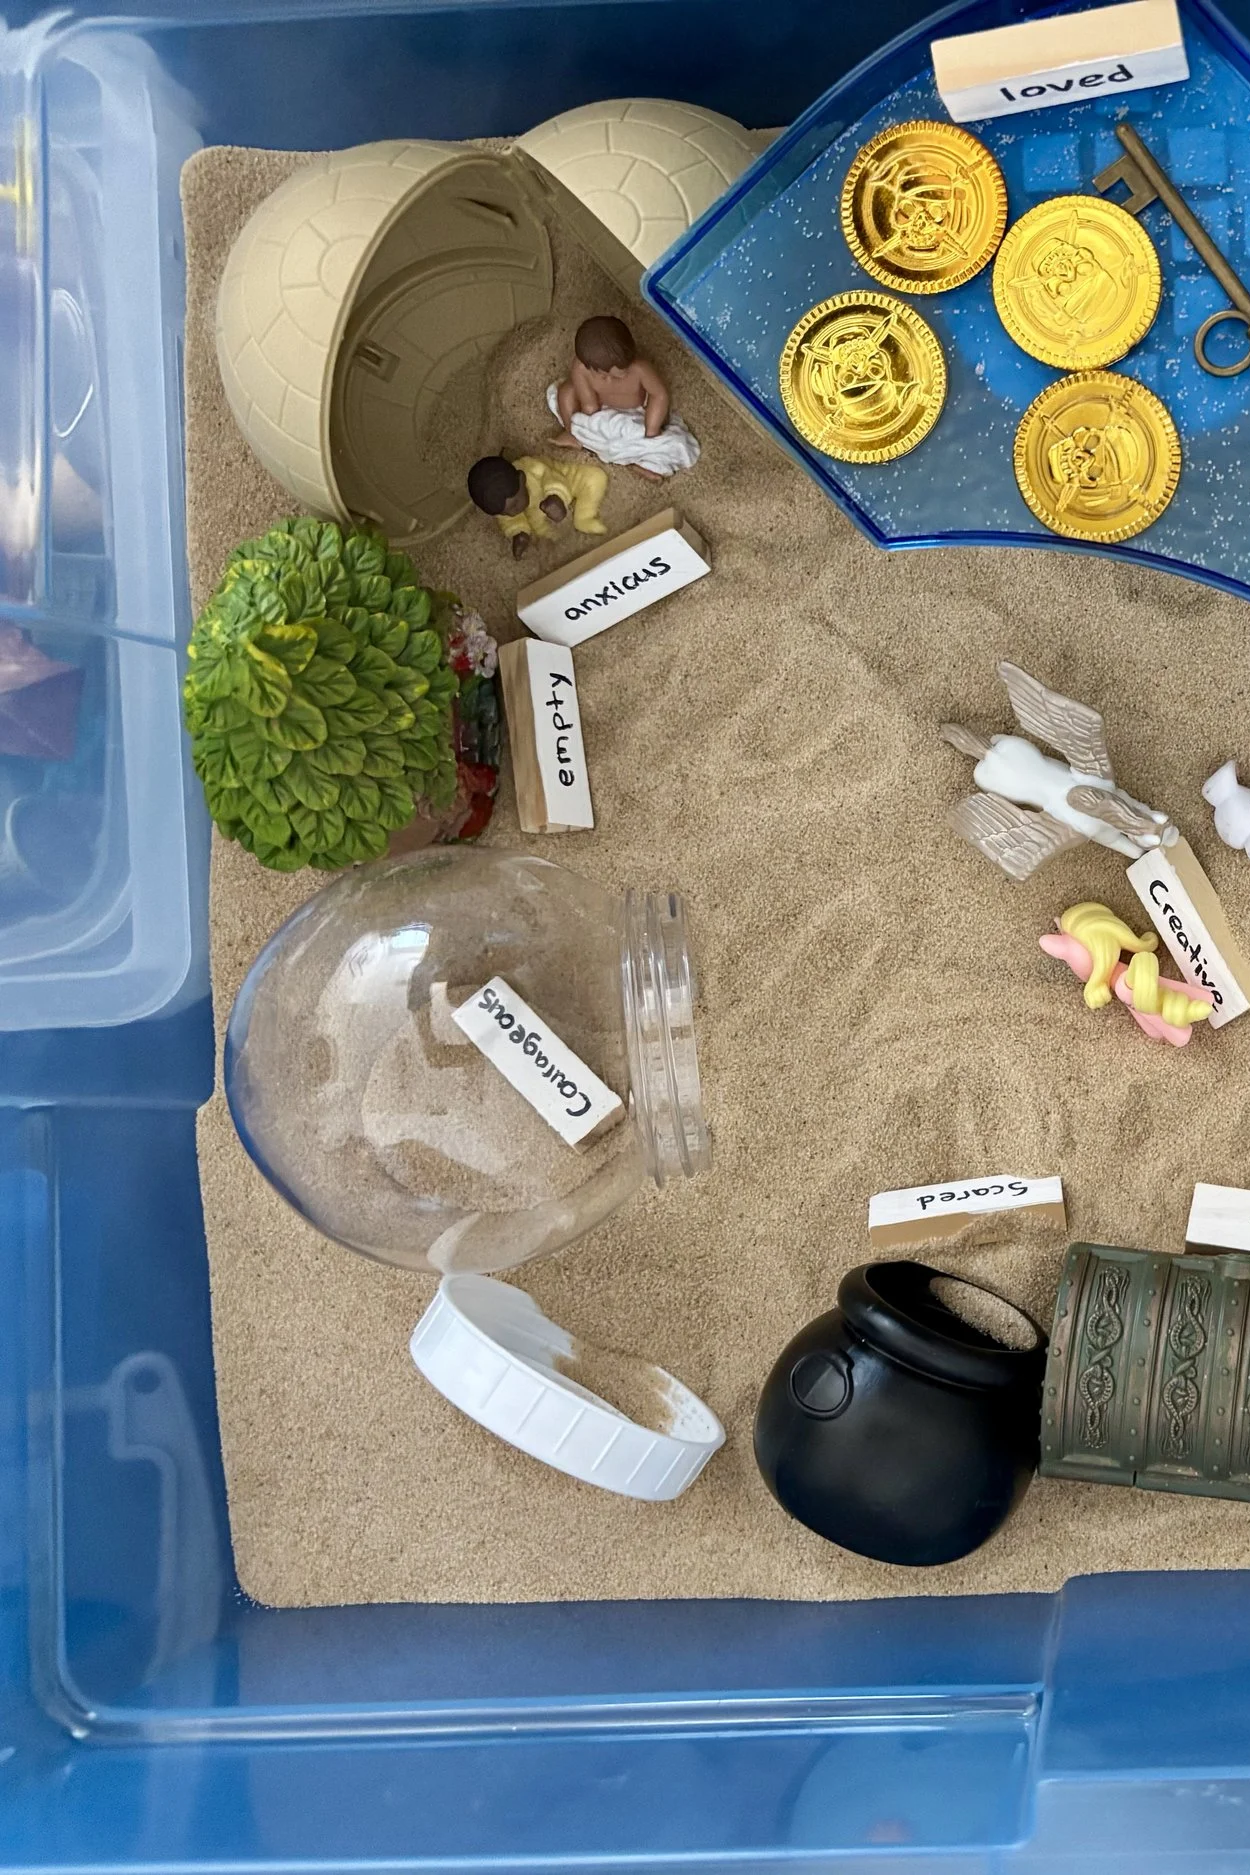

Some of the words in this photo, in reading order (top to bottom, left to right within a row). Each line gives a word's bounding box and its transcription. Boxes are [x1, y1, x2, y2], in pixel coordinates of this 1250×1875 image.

[1000, 64, 1134, 102] loved
[564, 556, 672, 621] anxious
[546, 672, 574, 787] empty
[1149, 879, 1224, 1013] Creative
[479, 987, 592, 1117] Courageous
[916, 1180, 1029, 1210] Scared
